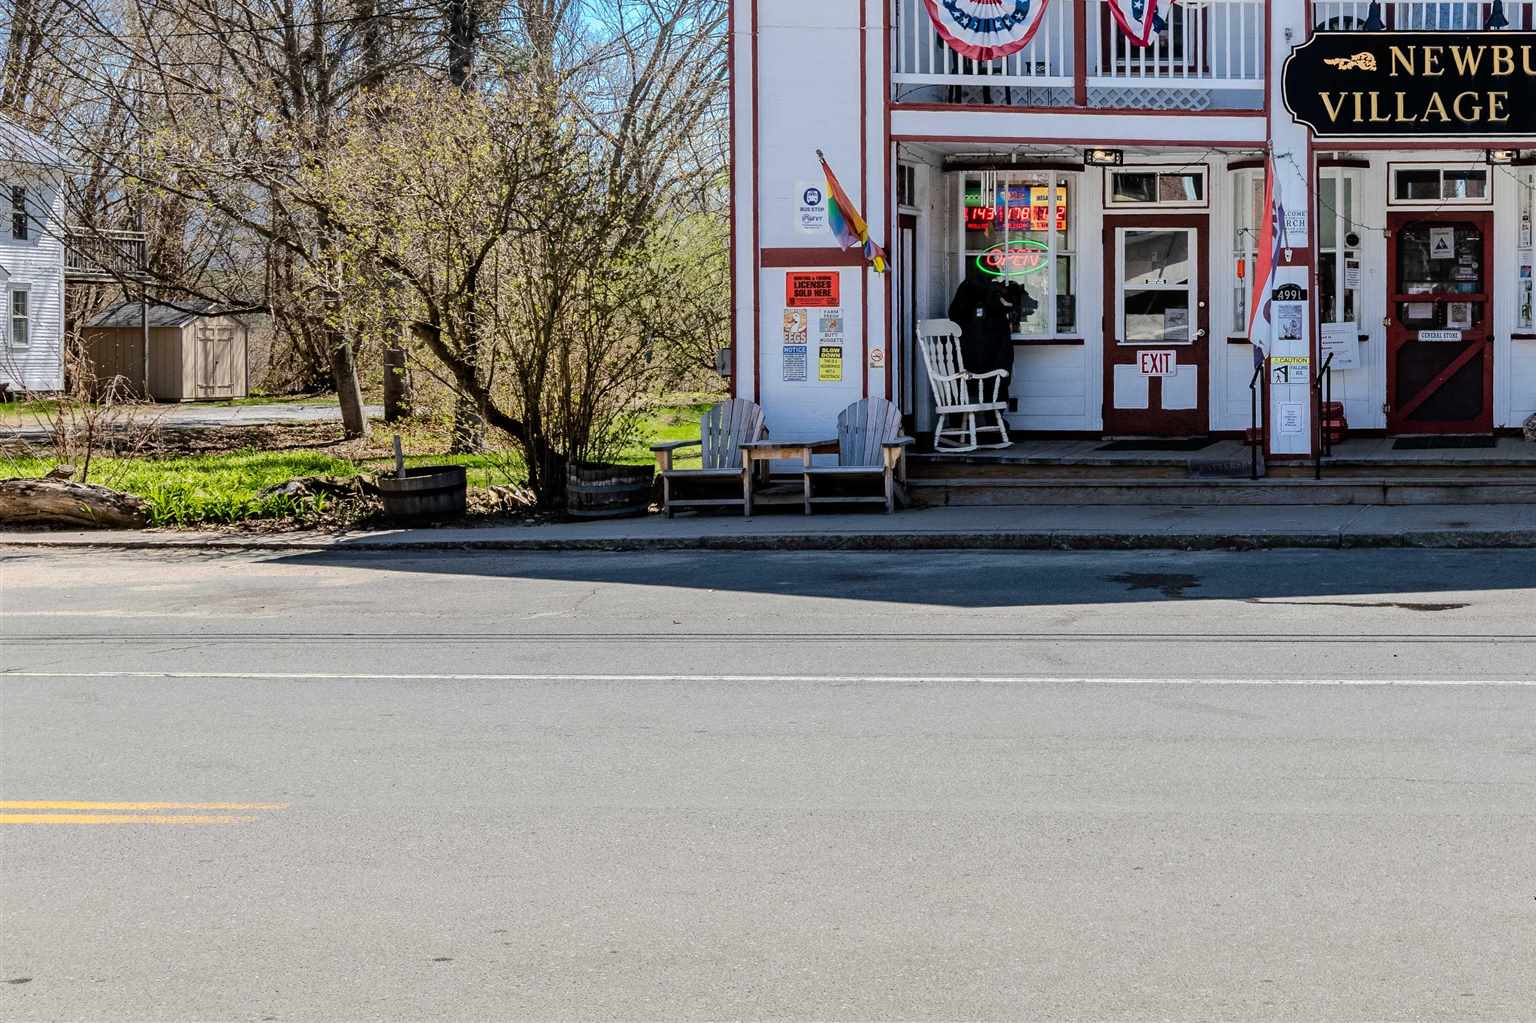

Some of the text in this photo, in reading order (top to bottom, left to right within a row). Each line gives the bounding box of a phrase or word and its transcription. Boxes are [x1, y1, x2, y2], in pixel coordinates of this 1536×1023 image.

[1318, 91, 1509, 123] VILLAGE
[986, 248, 1041, 266] OPEN
[793, 281, 832, 289] LICENSES
[793, 289, 832, 297] SOLD HERE
[1277, 289, 1301, 300] 4991
[1141, 353, 1171, 374] EXIT
